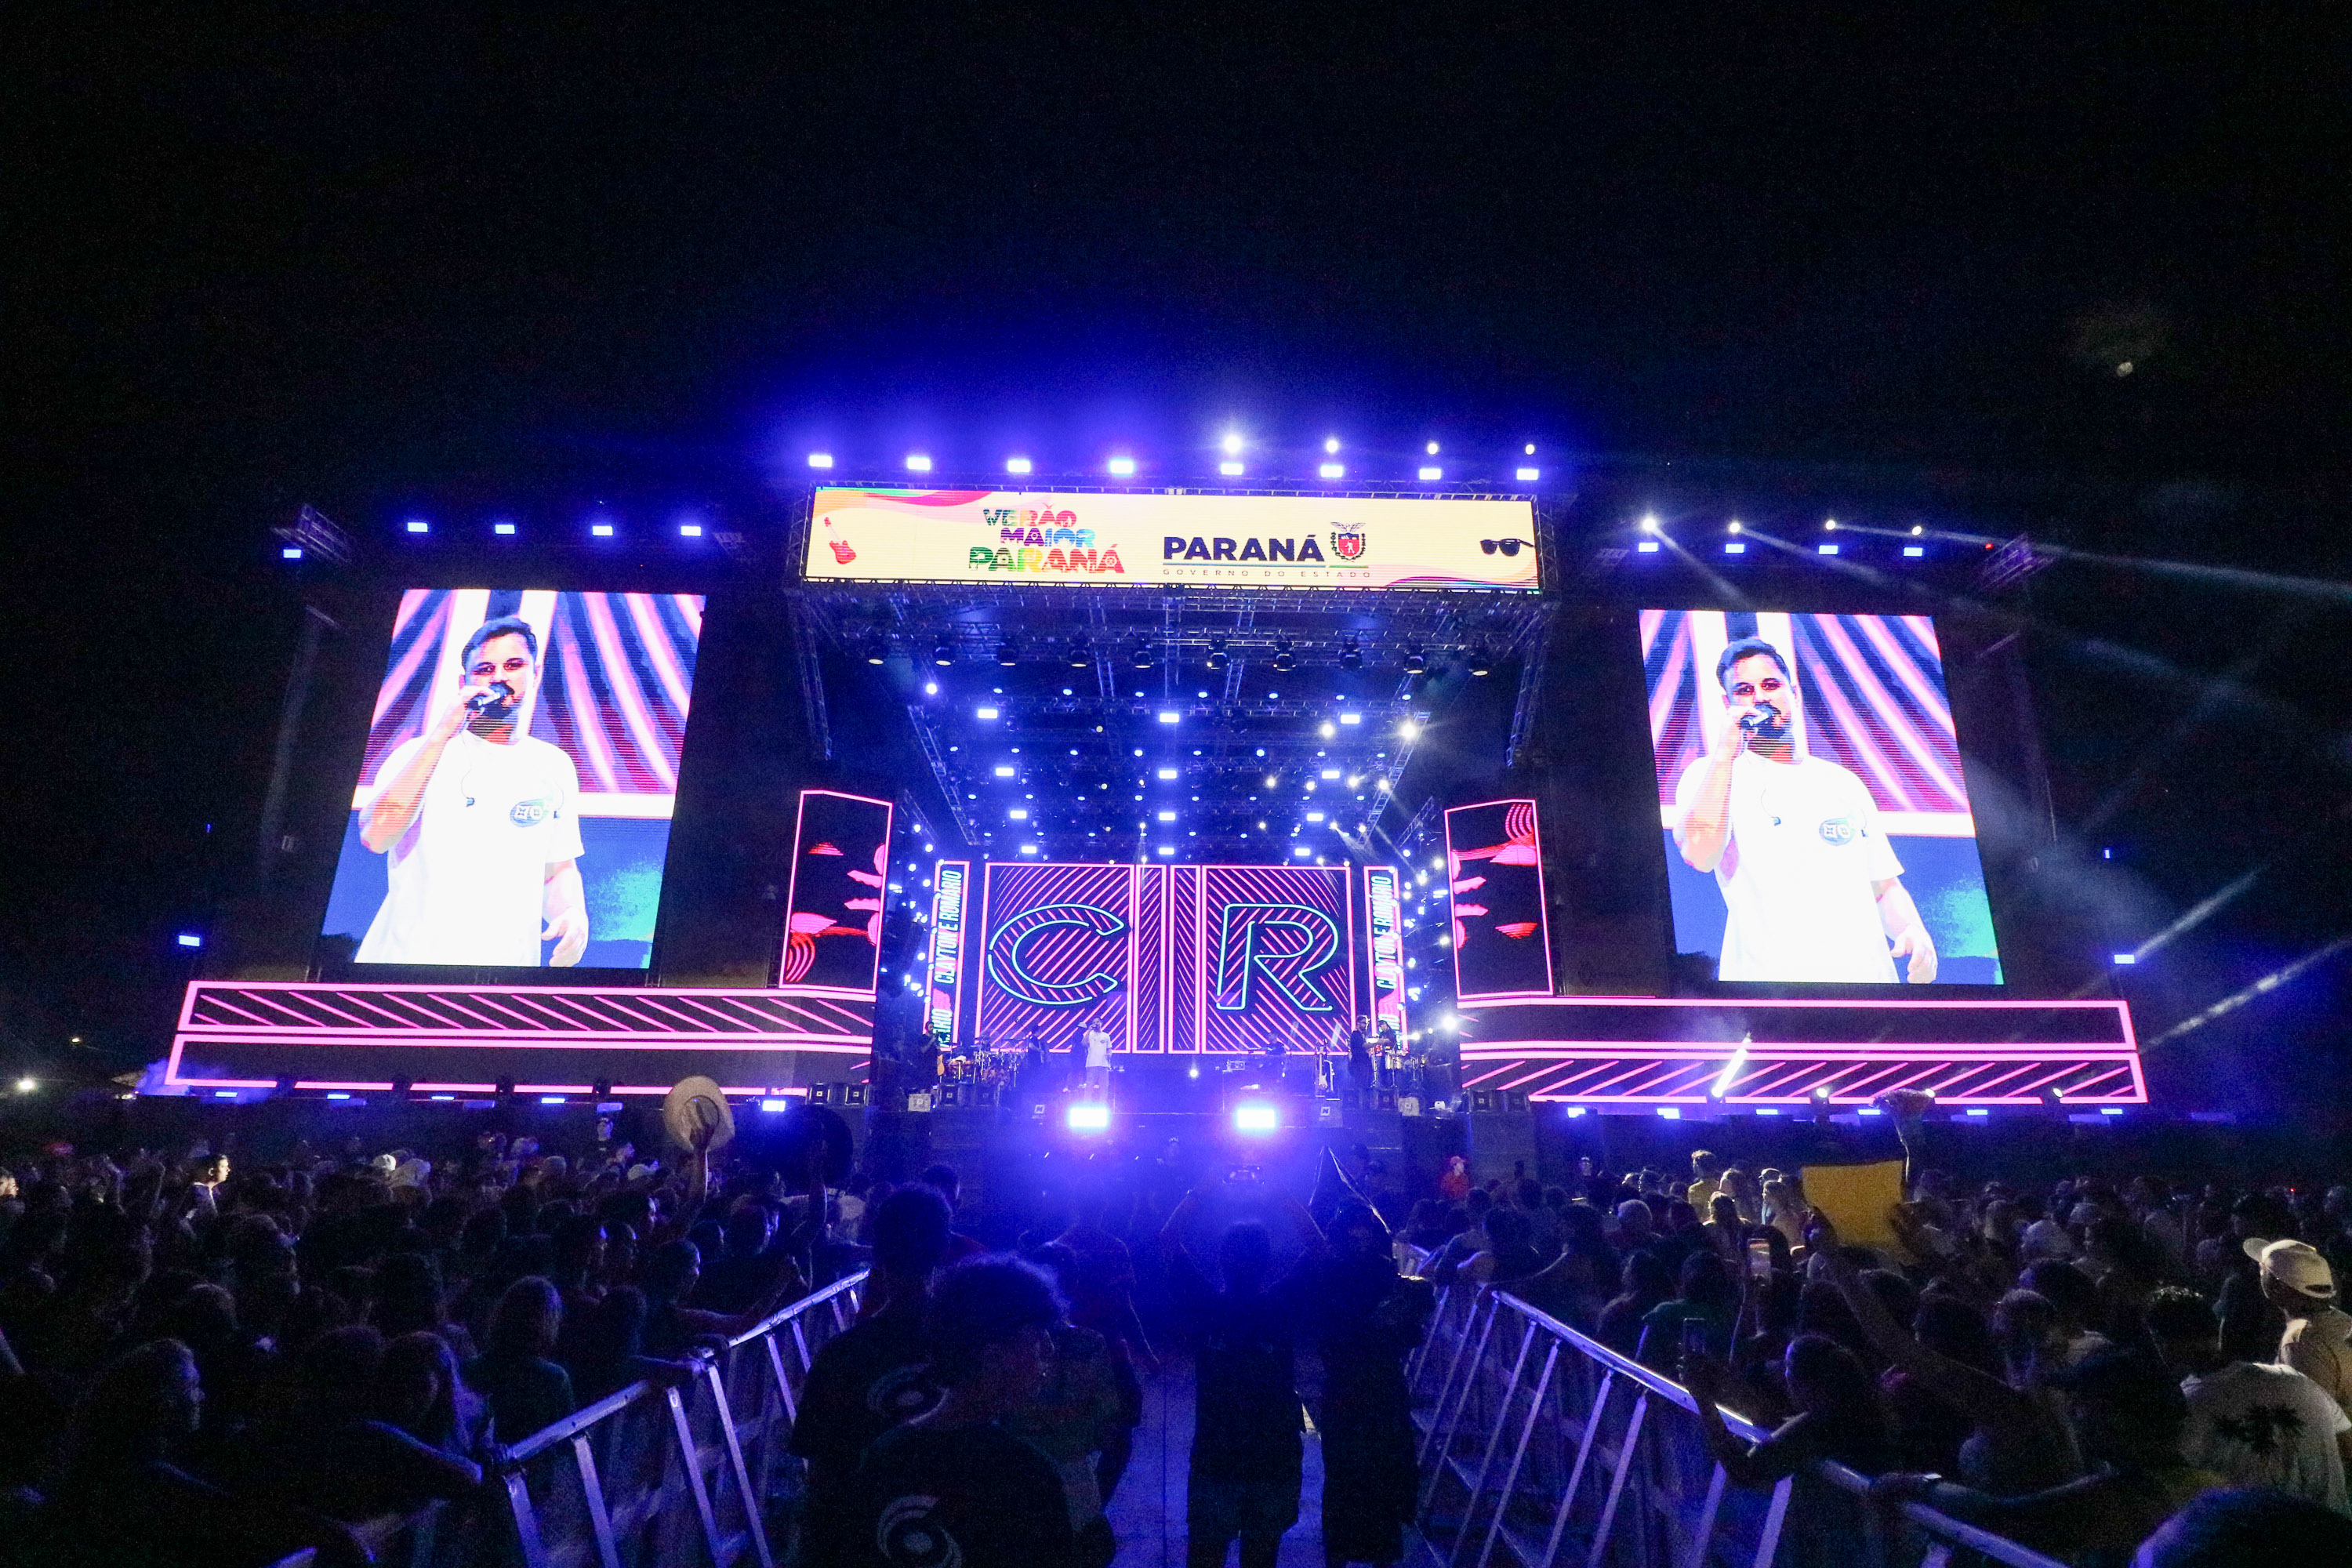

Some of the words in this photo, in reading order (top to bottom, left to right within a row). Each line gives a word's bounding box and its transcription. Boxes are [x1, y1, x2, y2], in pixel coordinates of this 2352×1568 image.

[983, 503, 1077, 528] VERÃO
[1000, 528, 1096, 548] MAIOR
[1164, 535, 1325, 562] PARANÁ
[969, 543, 1125, 574] PARANÁ
[1163, 568, 1249, 578] GOVERNO
[938, 921, 959, 931] E
[934, 931, 957, 984] CLAYTON
[988, 904, 1124, 1004] C
[1218, 903, 1338, 1010] R
[1374, 937, 1398, 990] CLAYTON
